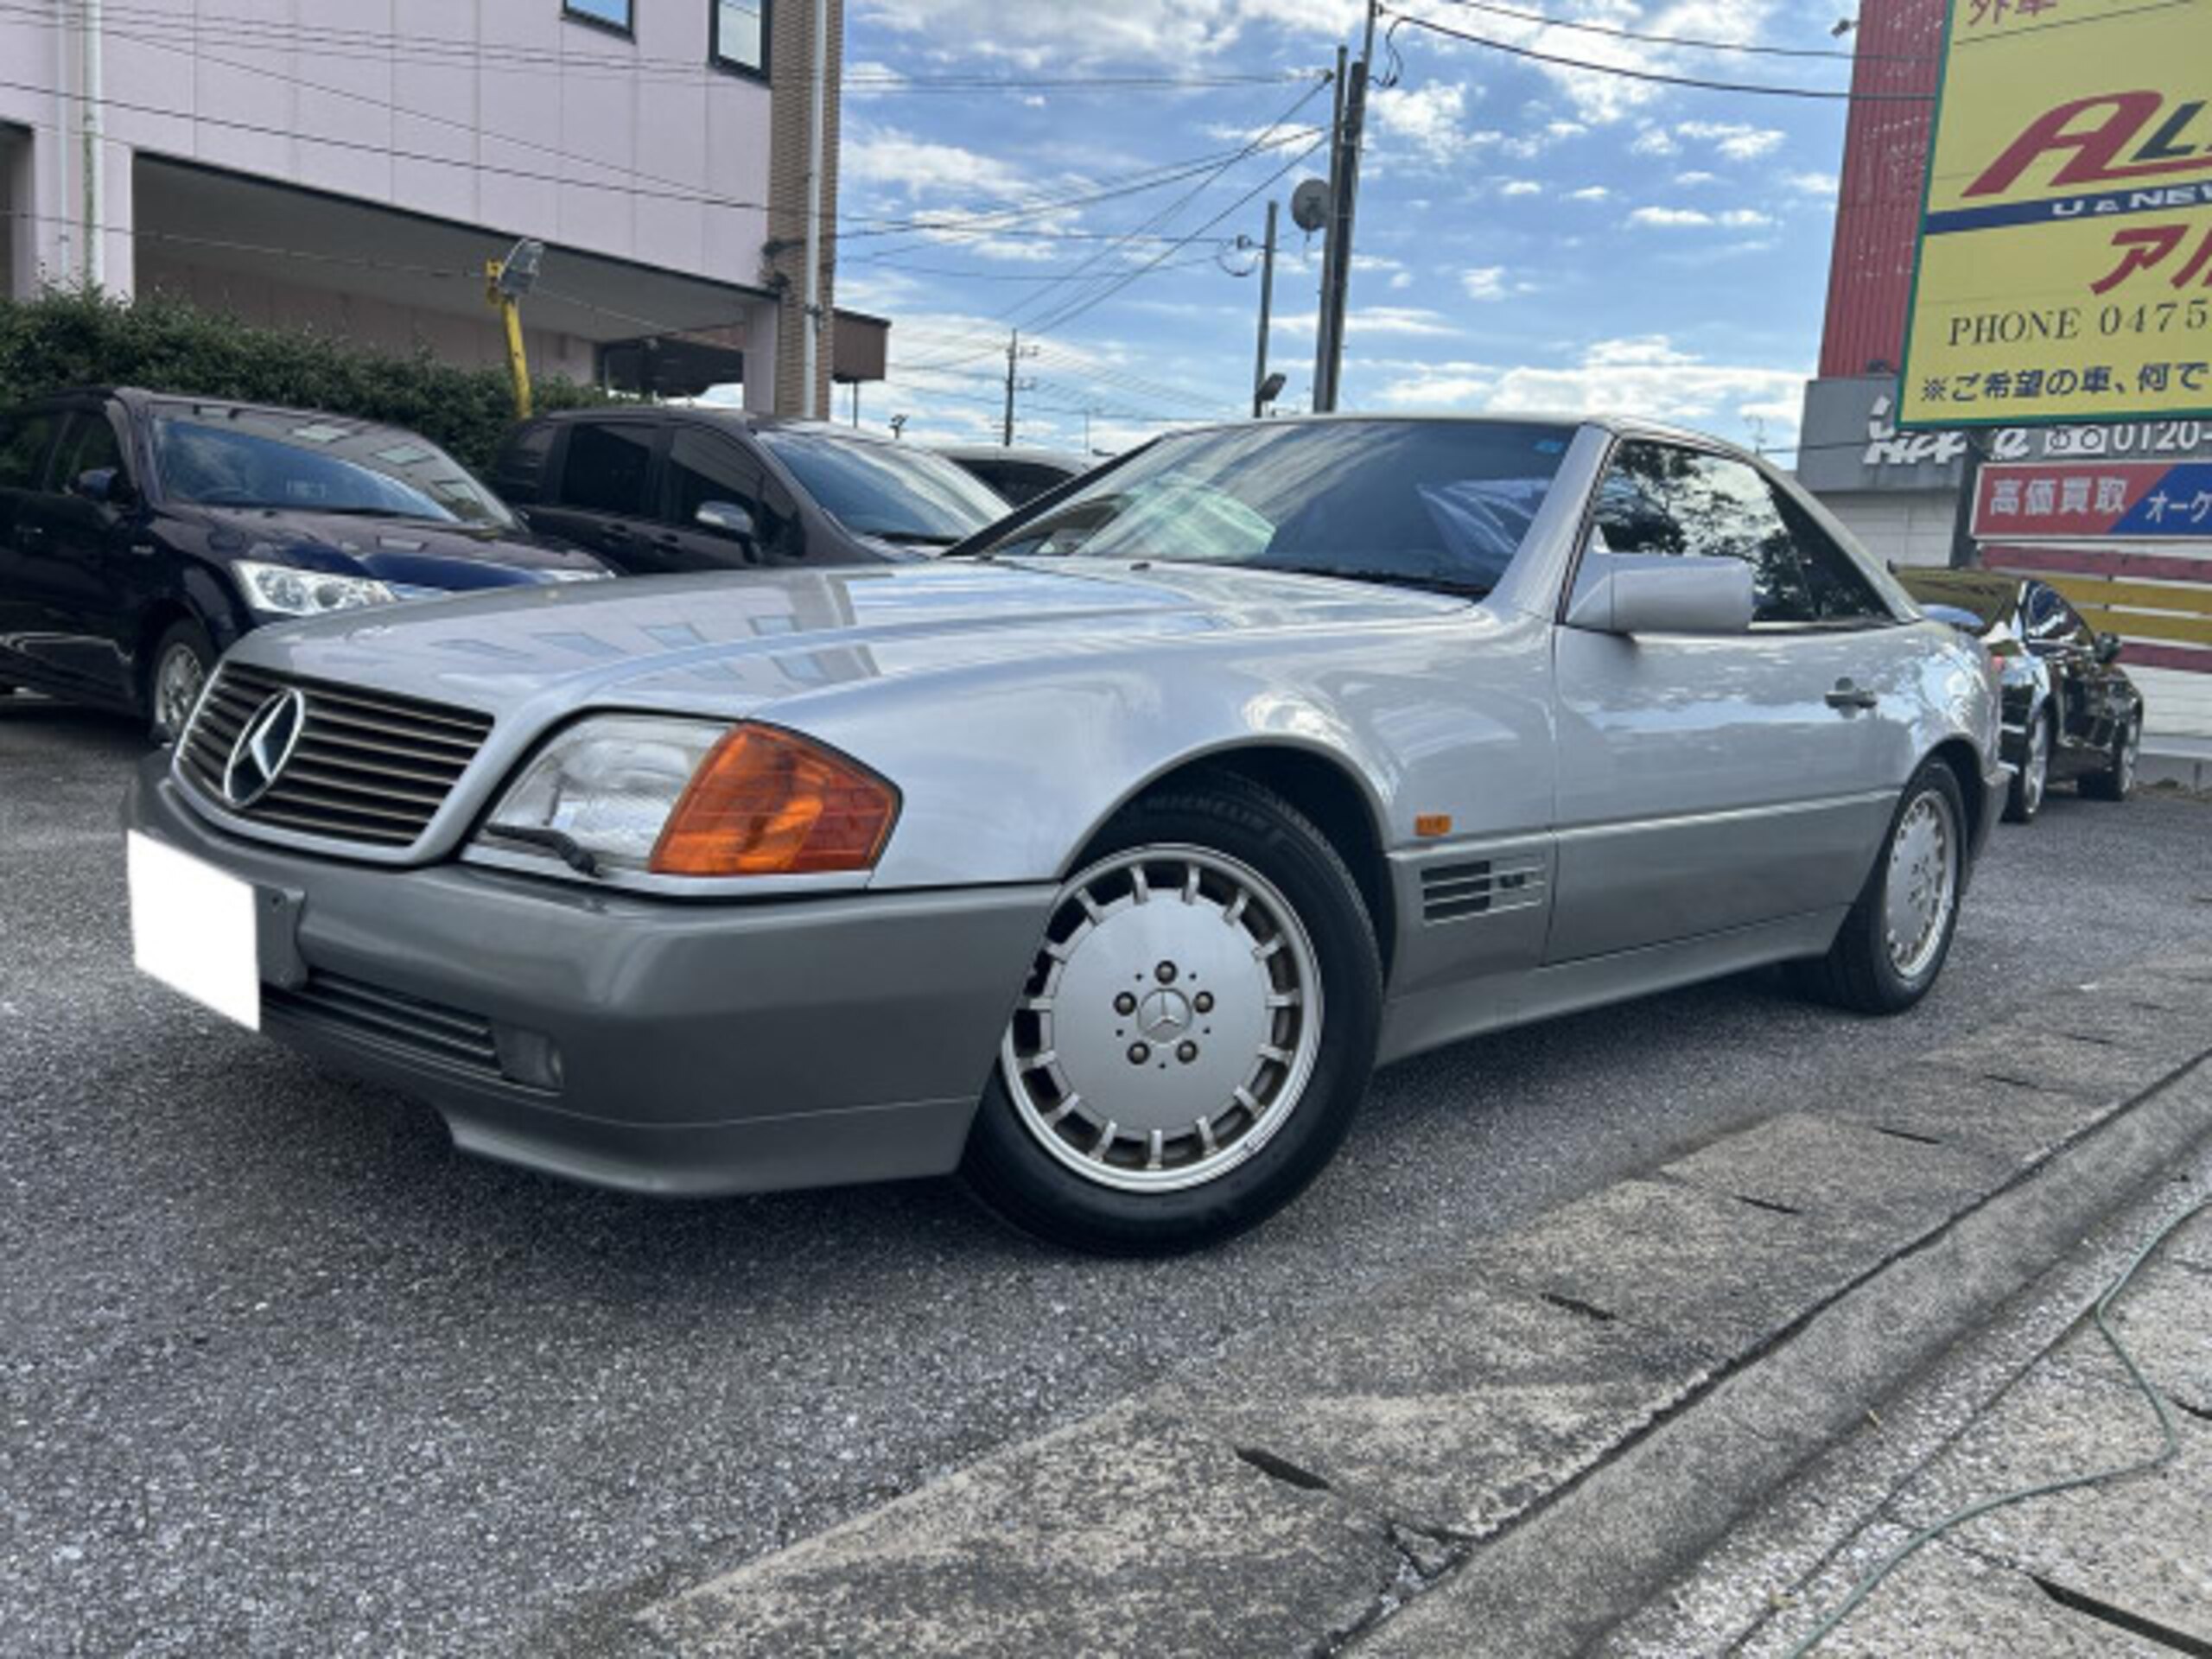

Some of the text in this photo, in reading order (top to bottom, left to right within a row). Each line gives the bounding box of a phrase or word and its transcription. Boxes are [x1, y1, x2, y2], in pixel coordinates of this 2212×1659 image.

[1960, 90, 2212, 198] AL
[1948, 299, 2208, 346] PHONE 0475
[1990, 477, 2127, 516] 高価買取
